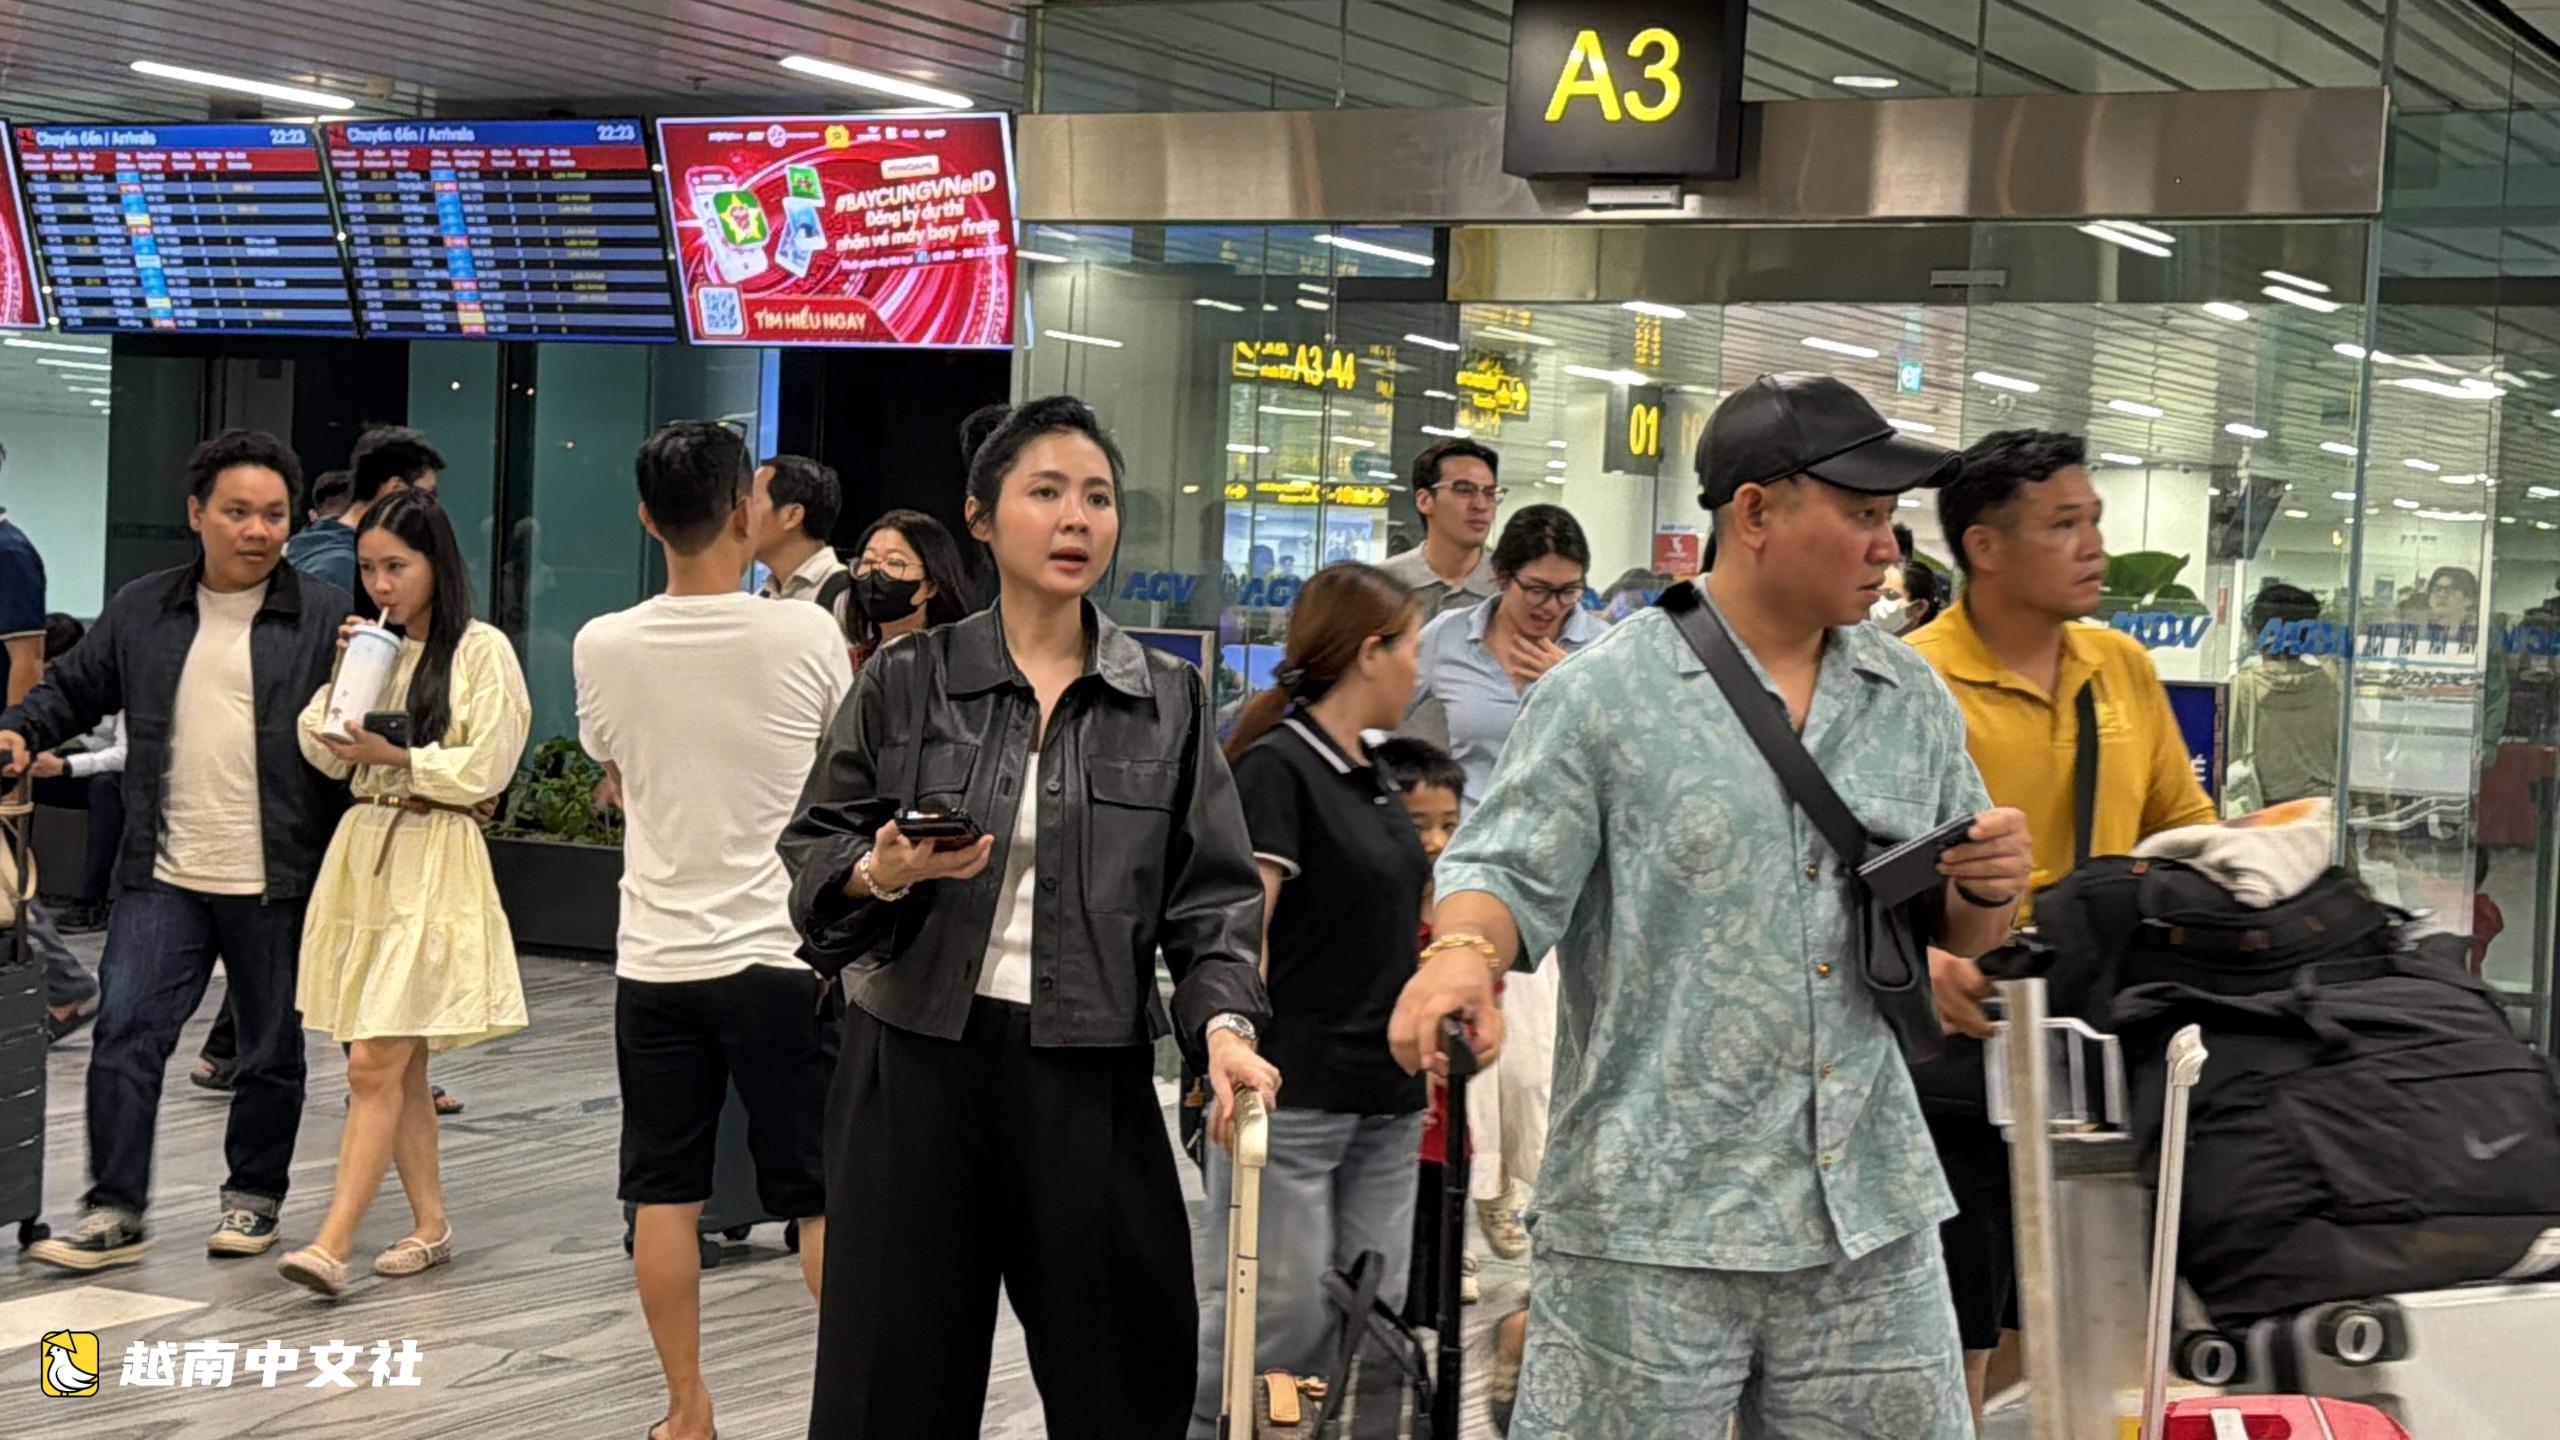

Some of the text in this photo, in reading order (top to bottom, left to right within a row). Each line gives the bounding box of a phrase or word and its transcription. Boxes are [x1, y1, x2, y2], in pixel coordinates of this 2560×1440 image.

[1544, 27, 1682, 122] A3
[270, 129, 306, 145] 22:23
[597, 125, 635, 140] 22:23
[927, 222, 960, 242] bay
[1629, 403, 1659, 457] 01
[1120, 570, 1198, 604] ACV
